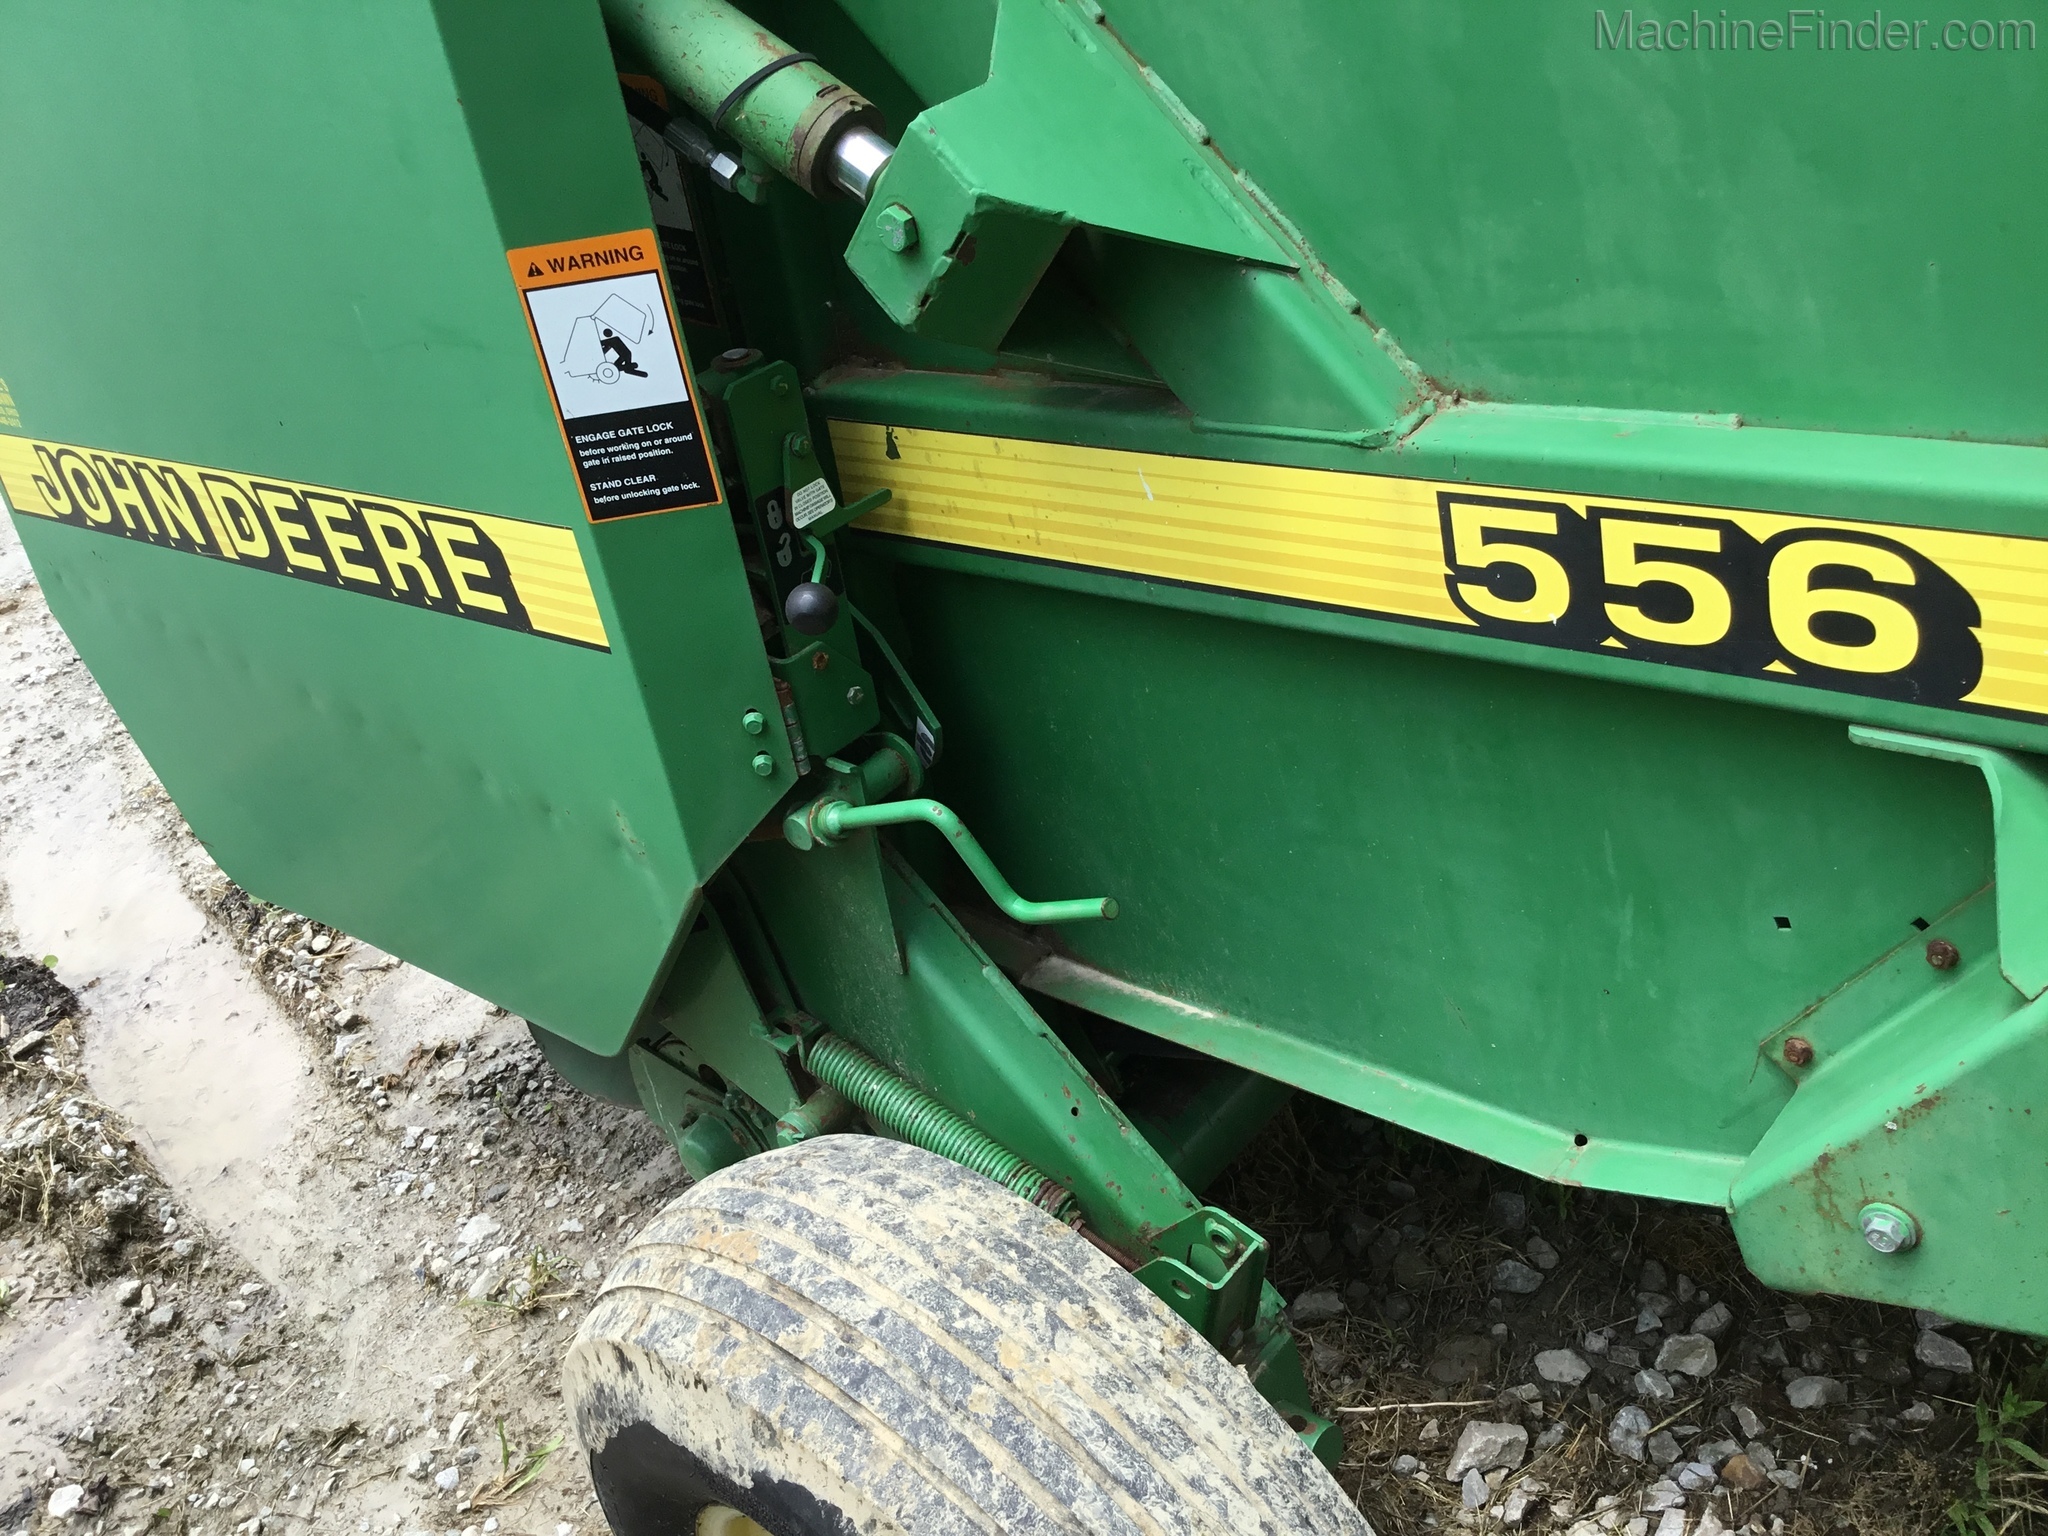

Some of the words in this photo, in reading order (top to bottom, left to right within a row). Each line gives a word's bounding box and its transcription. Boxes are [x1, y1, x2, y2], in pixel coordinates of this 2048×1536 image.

[546, 245, 645, 273] WARNING
[574, 430, 616, 444] ENGAGE
[618, 425, 645, 438] GATE
[646, 421, 674, 433] LOCK
[579, 448, 606, 457] before
[606, 442, 640, 453] working
[654, 438, 662, 446] or
[664, 432, 693, 444] around
[583, 457, 600, 468] gate
[602, 454, 610, 464] in
[612, 452, 637, 463] raised
[638, 448, 674, 460] position.
[590, 479, 622, 492] STAND
[624, 474, 656, 486] CLEAR
[594, 494, 620, 504] before
[620, 488, 661, 500] unlocking
[662, 484, 680, 495] gate
[680, 481, 700, 491] lock.
[32, 445, 208, 552] JOHN
[200, 471, 512, 617] DEERE
[1441, 495, 1946, 684] 556
